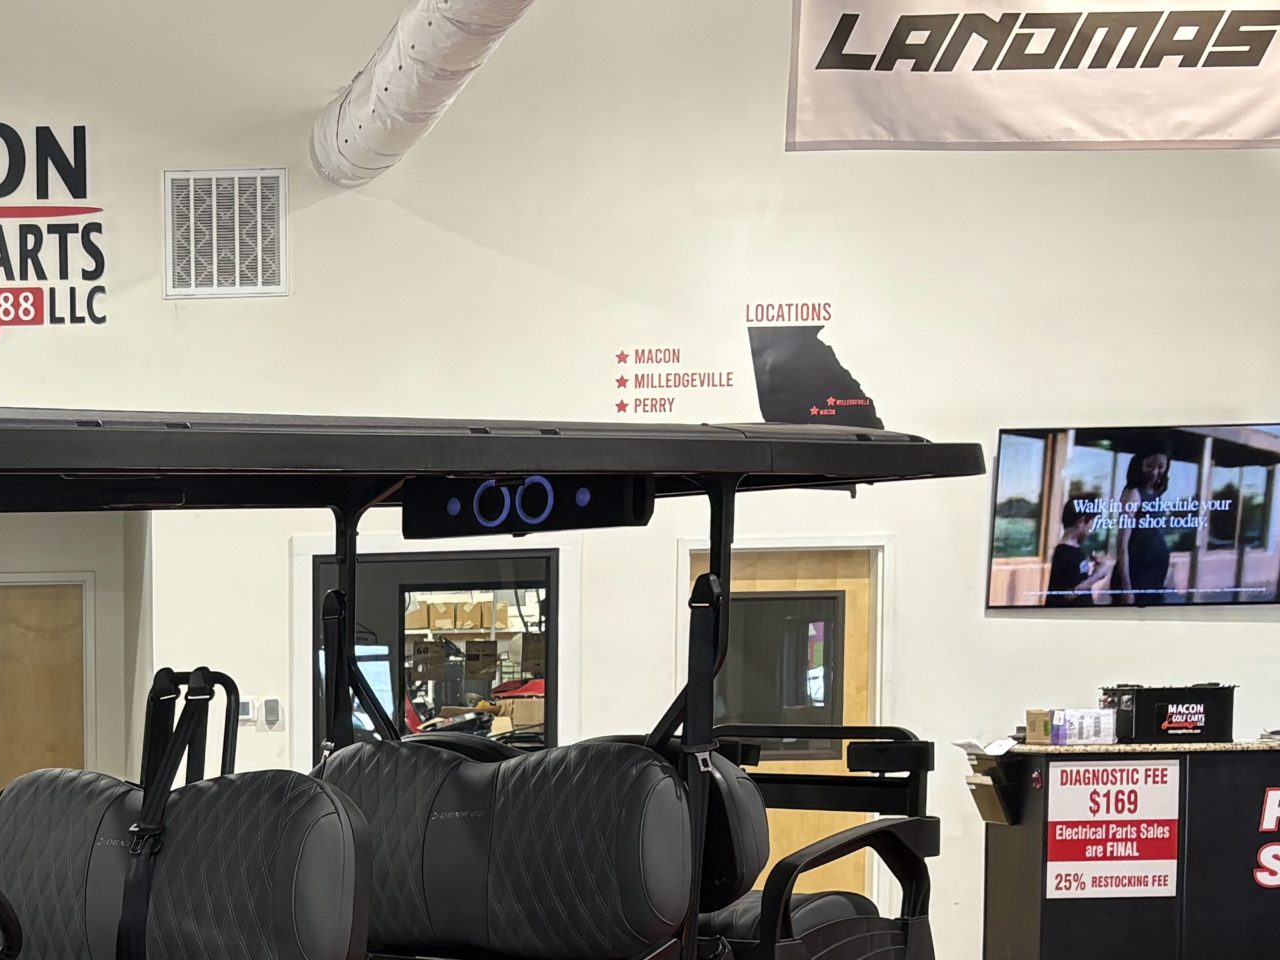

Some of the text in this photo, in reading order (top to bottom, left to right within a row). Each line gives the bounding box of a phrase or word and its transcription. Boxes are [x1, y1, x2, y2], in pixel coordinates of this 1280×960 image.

[48, 285, 107, 325] LLC
[745, 302, 832, 323] LOCATIONS
[634, 348, 680, 364] MACON
[634, 371, 734, 389] MILLEDGEVILLE
[634, 397, 675, 413] PERRY
[1073, 497, 1233, 516] Walk in or schedule your
[1088, 513, 1208, 533] free flu shot today.
[1168, 704, 1204, 713] MACON
[1060, 767, 1169, 786] DIAGNOSTIC FEE
[1089, 788, 1139, 817] $169
[1055, 822, 1170, 840] Electrical Parts Sales
[1085, 841, 1140, 857] are FINAL
[1054, 873, 1169, 891] 25% RESTOCKING FEE
